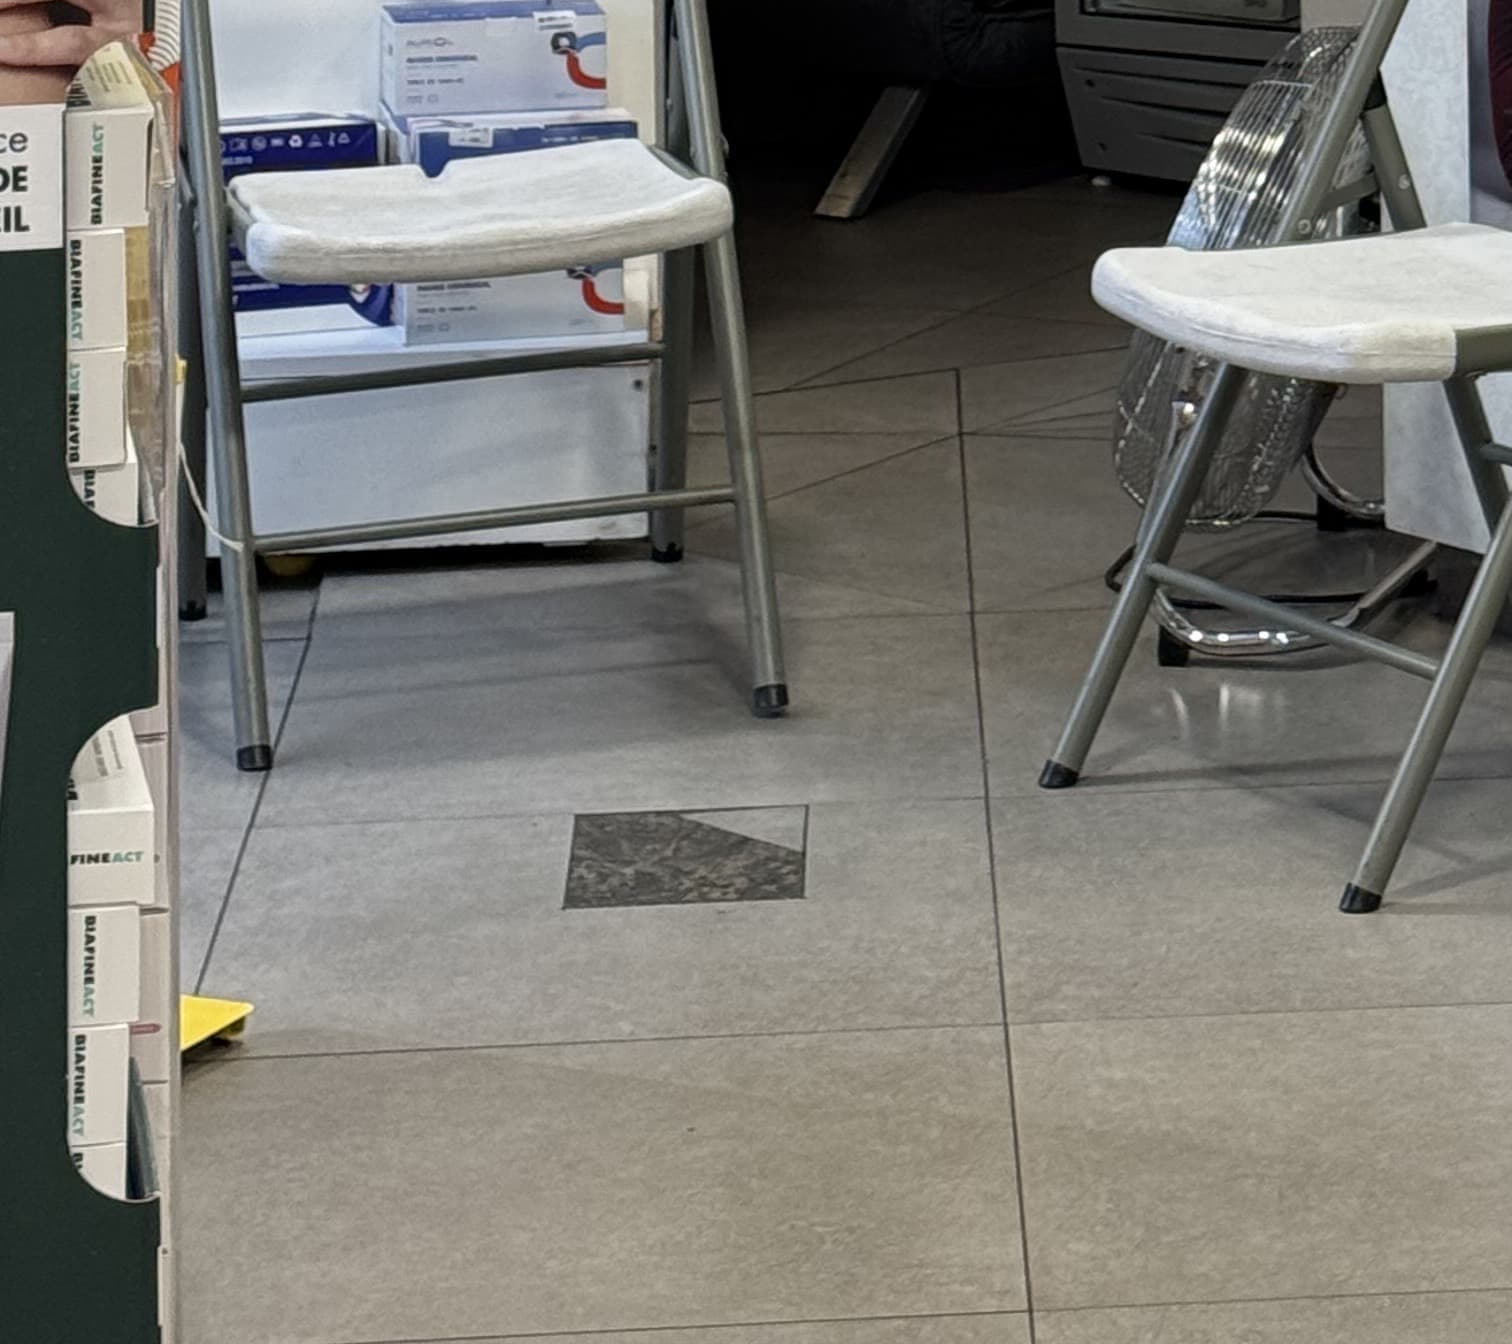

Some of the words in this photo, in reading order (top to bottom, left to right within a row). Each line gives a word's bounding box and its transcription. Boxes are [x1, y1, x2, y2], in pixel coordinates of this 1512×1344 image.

[91, 123, 105, 224] BIAFINEACT
[70, 239, 83, 340] BIAFINEACT
[69, 362, 81, 463] BIAFINEACT
[83, 915, 97, 1019] BIAFINEACT
[72, 1034, 87, 1137] BIAFINEACT
